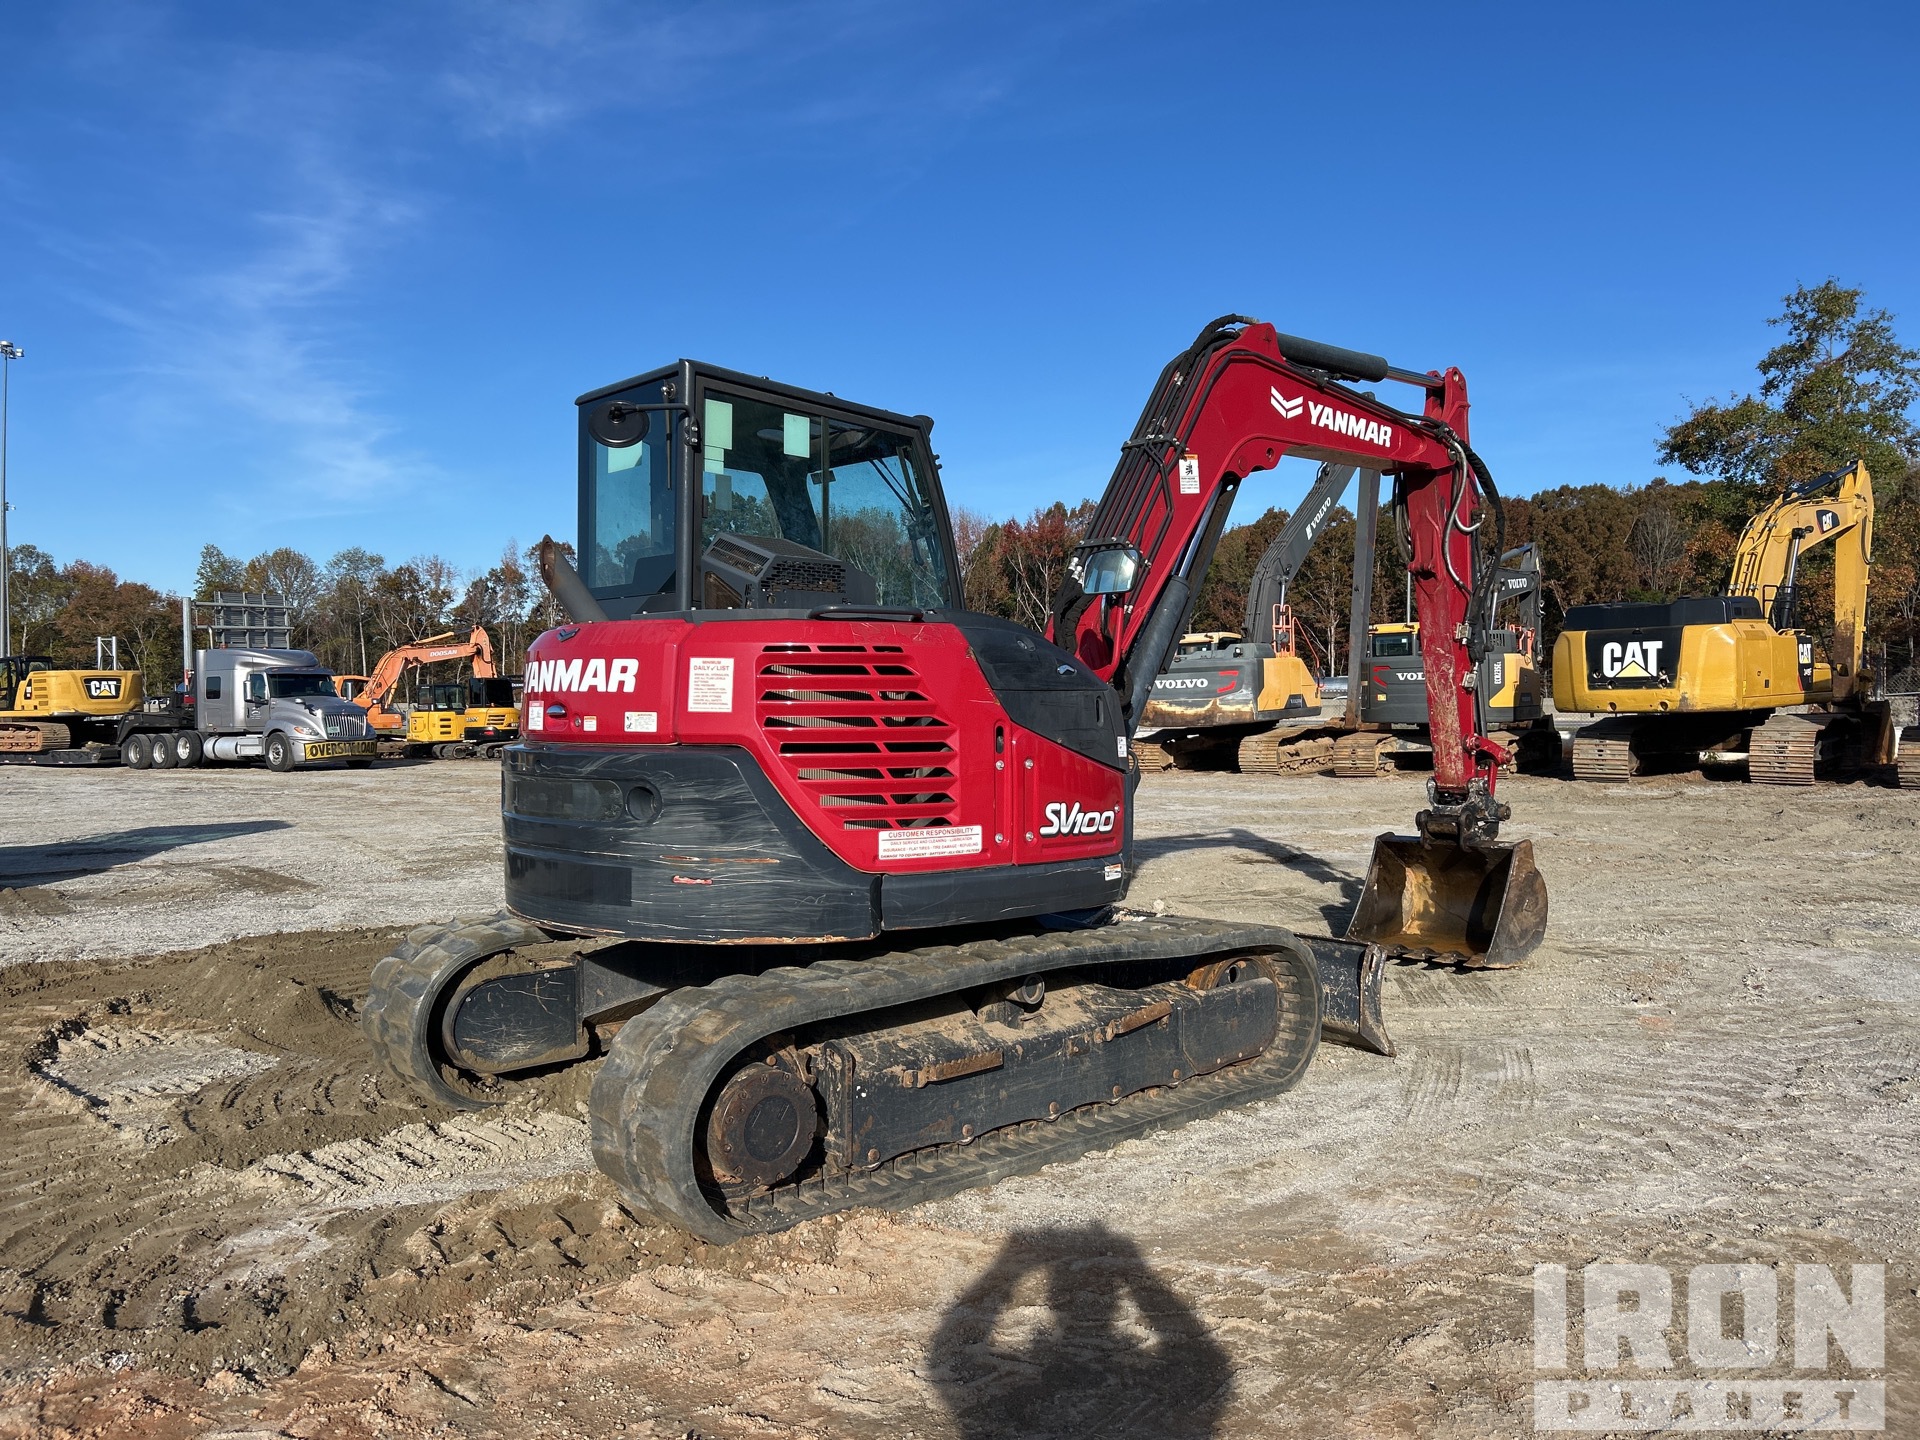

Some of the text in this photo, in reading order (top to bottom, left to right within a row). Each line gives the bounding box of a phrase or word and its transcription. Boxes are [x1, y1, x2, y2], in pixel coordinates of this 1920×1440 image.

[1308, 401, 1392, 448] YANMAR
[1311, 496, 1331, 529] VOLVO
[1822, 511, 1833, 531] CAT
[1507, 577, 1527, 589] VOLVO
[429, 649, 458, 657] DOOSAN
[1602, 640, 1663, 678] CAT
[1798, 643, 1812, 664] CAT
[524, 658, 639, 694] YANMAR
[1154, 678, 1209, 689] VOLVO
[1396, 672, 1426, 681] VOL
[90, 680, 117, 696] CAT
[310, 741, 375, 757] OVERSIZE LOAD
[1039, 801, 1115, 836] SV100
[888, 827, 974, 838] CUSTOMER RESPONSIBILITY
